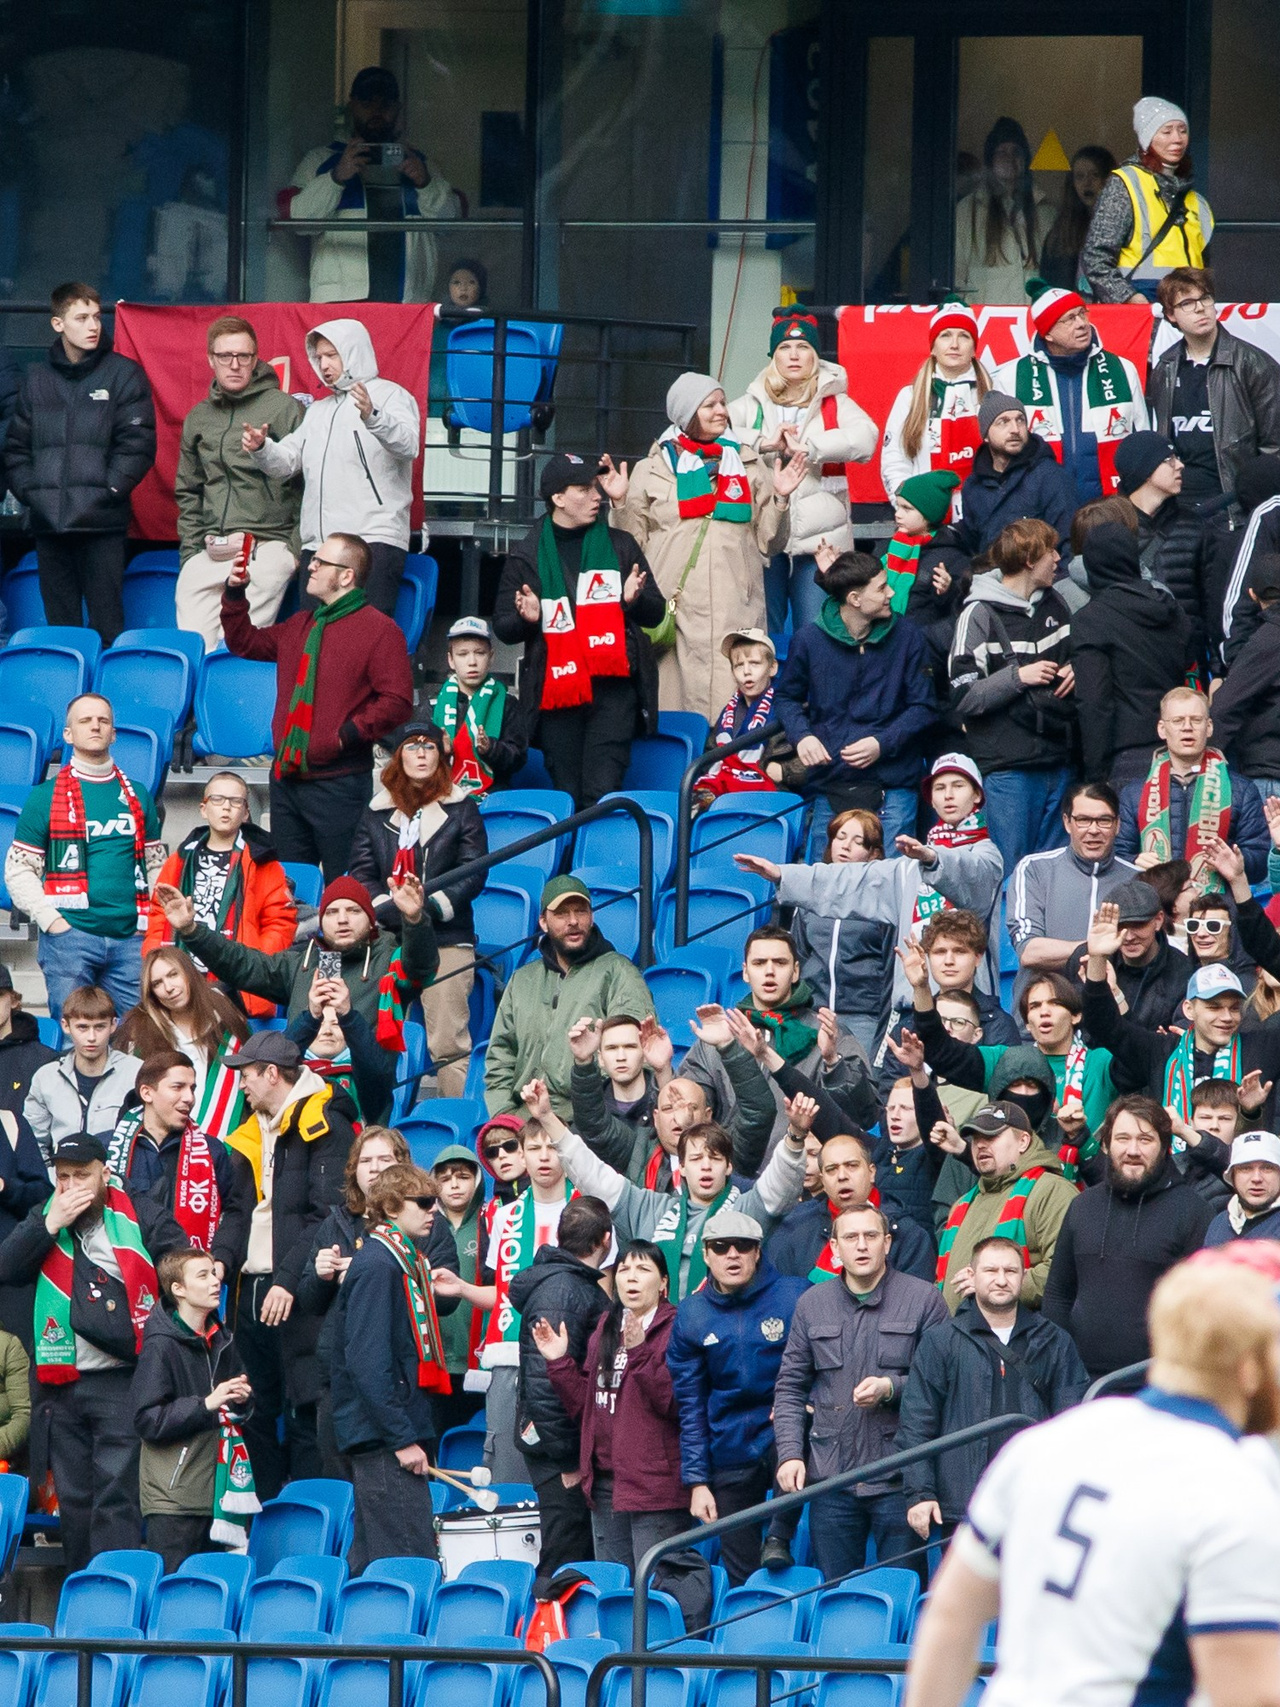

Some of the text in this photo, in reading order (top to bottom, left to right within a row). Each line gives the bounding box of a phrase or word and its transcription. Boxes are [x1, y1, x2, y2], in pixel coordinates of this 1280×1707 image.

[916, 896, 946, 918] 1922
[188, 1179, 210, 1214] ФК
[1043, 1483, 1108, 1600] 5
